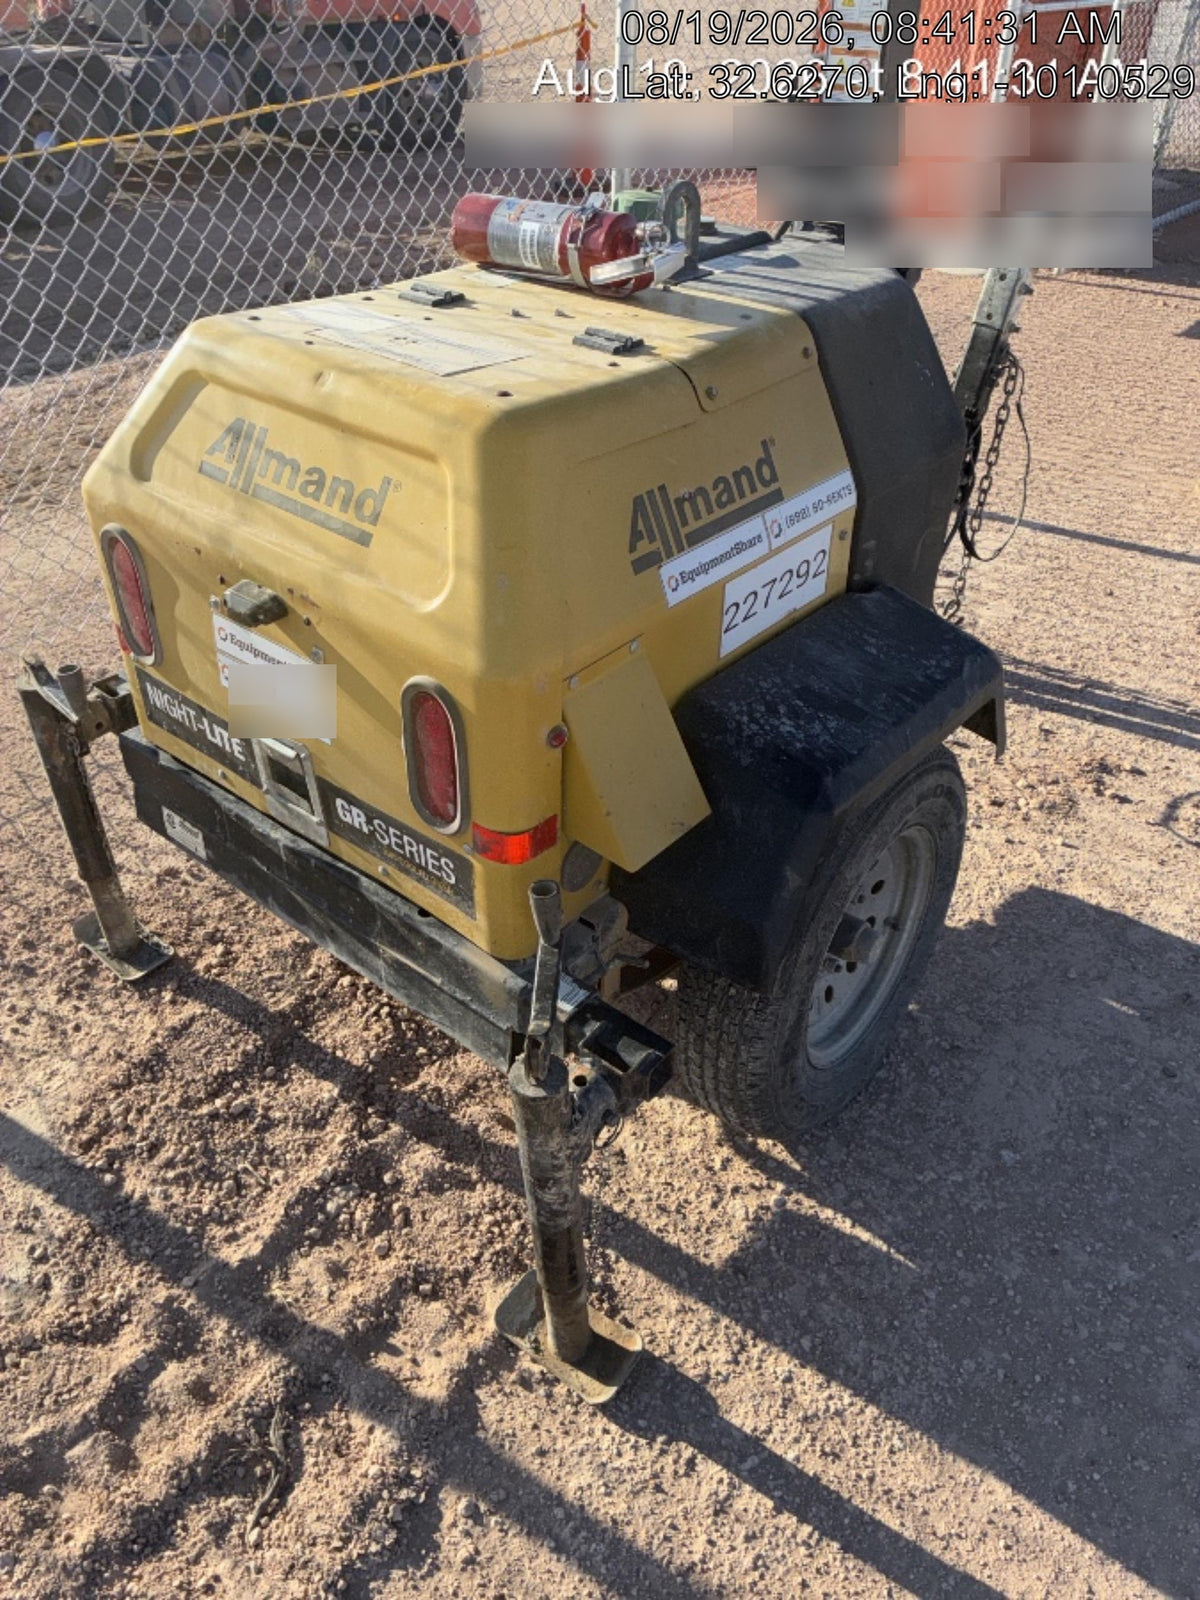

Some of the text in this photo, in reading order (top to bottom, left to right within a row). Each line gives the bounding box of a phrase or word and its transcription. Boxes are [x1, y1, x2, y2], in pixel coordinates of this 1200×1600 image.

[679, 532, 764, 586] EquipmentShare
[723, 548, 828, 635] 227292
[145, 681, 247, 764] NIGHT-LITE
[334, 797, 457, 885] GR-SERIES
